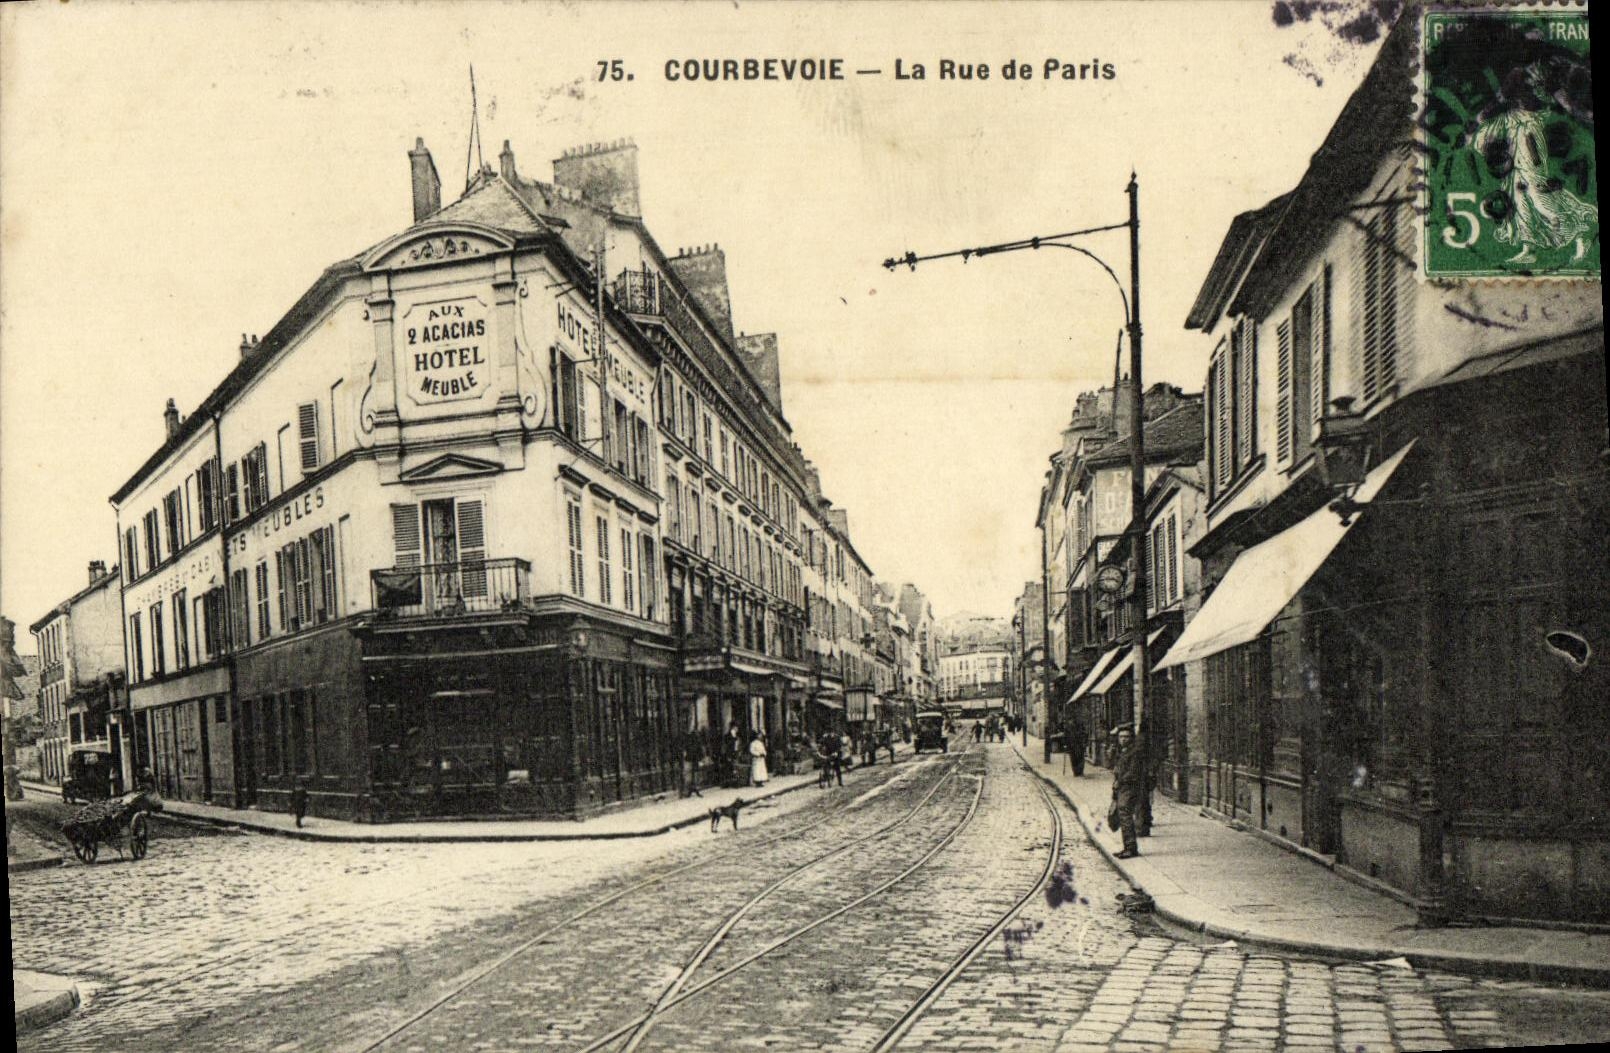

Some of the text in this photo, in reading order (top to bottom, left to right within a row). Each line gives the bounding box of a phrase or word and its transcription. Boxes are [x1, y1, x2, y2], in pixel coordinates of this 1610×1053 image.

[428, 305, 465, 320] AUX
[407, 318, 486, 346] 2 ACACIAS
[414, 345, 486, 372] HOTEL
[420, 370, 478, 397] MEUBLE
